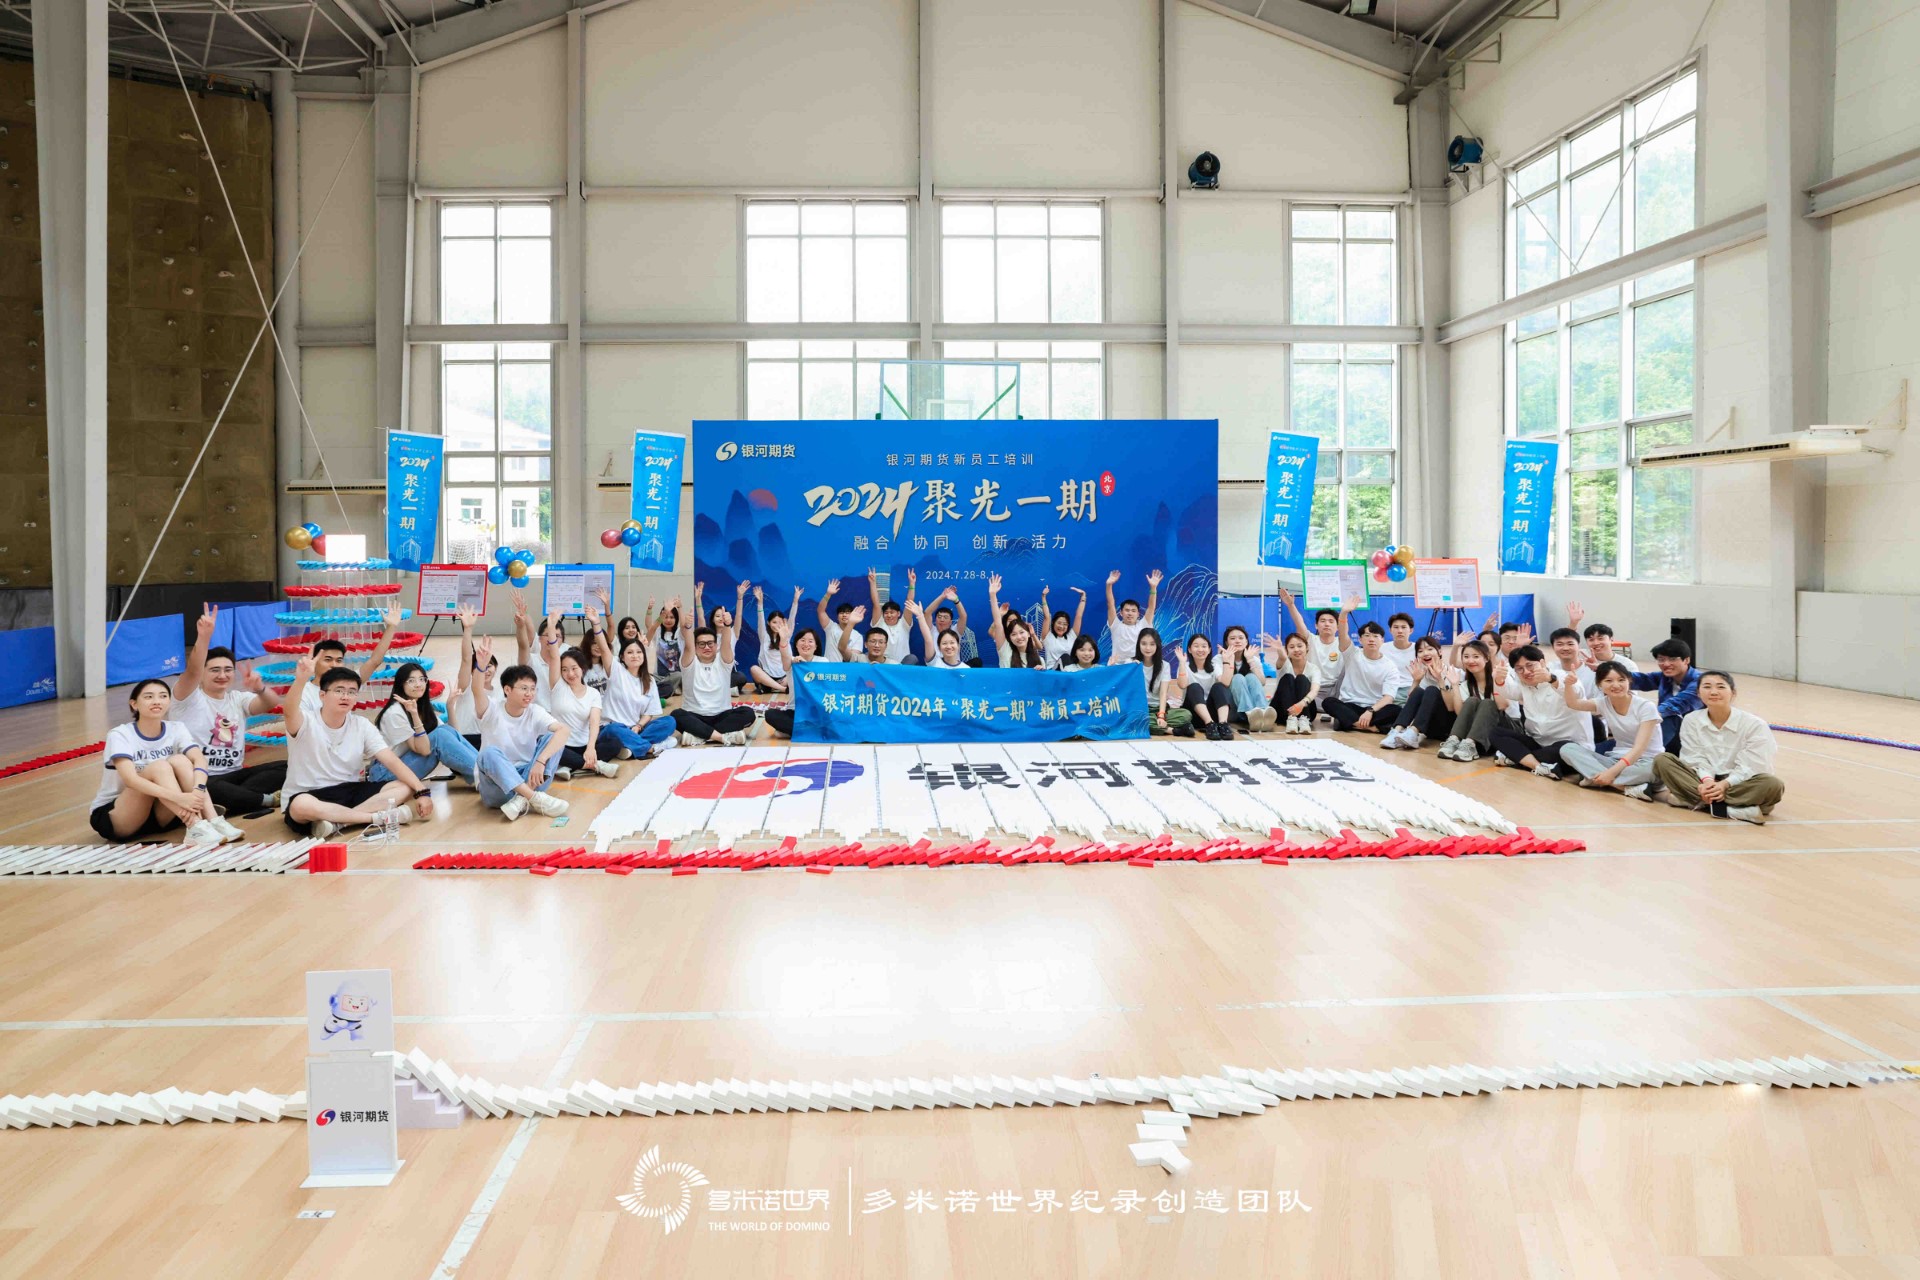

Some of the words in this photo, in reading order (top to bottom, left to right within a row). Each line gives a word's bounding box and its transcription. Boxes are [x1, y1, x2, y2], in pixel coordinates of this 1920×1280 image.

[741, 443, 796, 458] 银河期货
[886, 453, 1034, 466] 银河期货新员工培训
[1103, 474, 1113, 494] 北京
[399, 473, 420, 531] 聚光一期
[643, 472, 664, 531] 聚光一期
[1272, 471, 1295, 528] 聚光一期
[853, 535, 890, 551] 融合
[913, 534, 950, 550] 协同
[972, 534, 1008, 550] 创新
[1031, 533, 1067, 549] 活力
[816, 672, 847, 682] 银河期货
[339, 1110, 390, 1123] 银河期货
